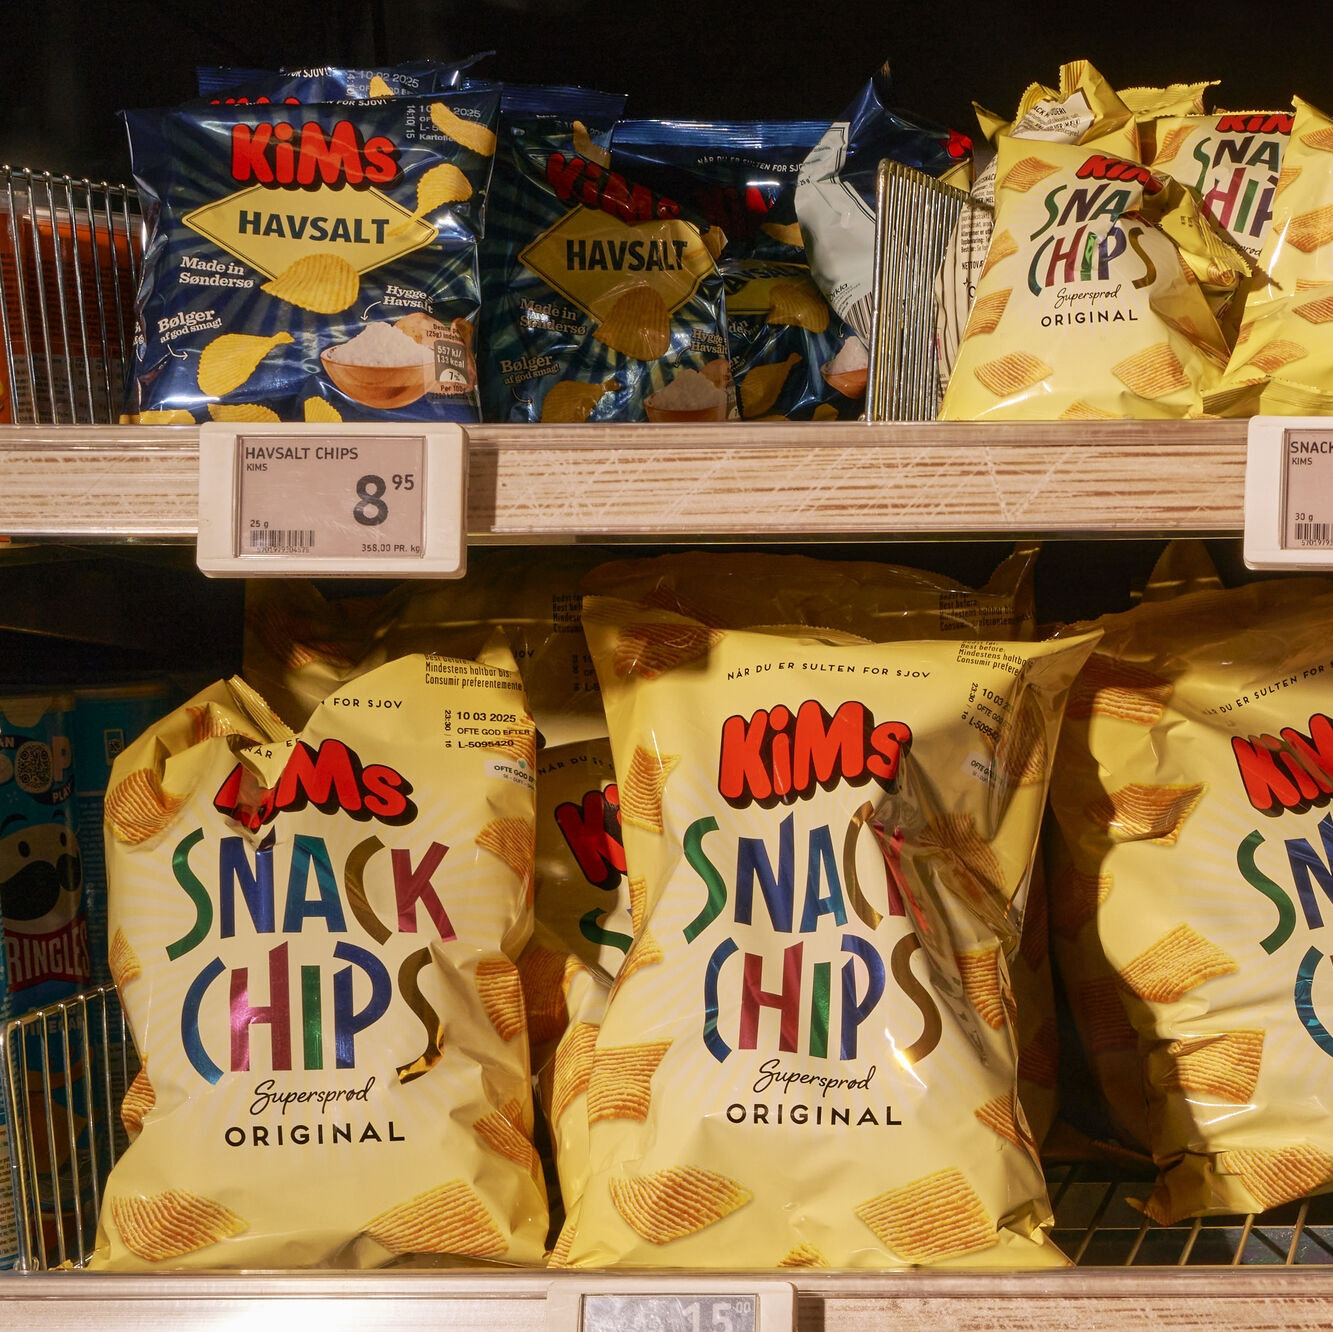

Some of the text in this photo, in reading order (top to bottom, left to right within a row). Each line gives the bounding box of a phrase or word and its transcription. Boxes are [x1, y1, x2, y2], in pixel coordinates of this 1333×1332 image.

[232, 121, 397, 184] KiMs
[238, 211, 389, 244] HAVSALT
[1028, 225, 1157, 296] CHIPS
[179, 271, 254, 288] Søndersø
[158, 309, 215, 331] Bølger
[1041, 309, 1138, 327] ORIGINAL
[246, 448, 358, 460] HAVSALT CHIPS
[1292, 457, 1312, 466] KIMS
[247, 463, 268, 471] KIMS
[353, 475, 414, 526] 8 95
[425, 674, 522, 690] Consumir preferentemente
[718, 700, 912, 809] KiMs
[166, 827, 457, 962] SNACK
[703, 933, 942, 1064] CHIPS
[182, 942, 444, 1085] CHIPS
[727, 1103, 902, 1126] ORIGINAL
[225, 1122, 405, 1146] ORIGINAL
